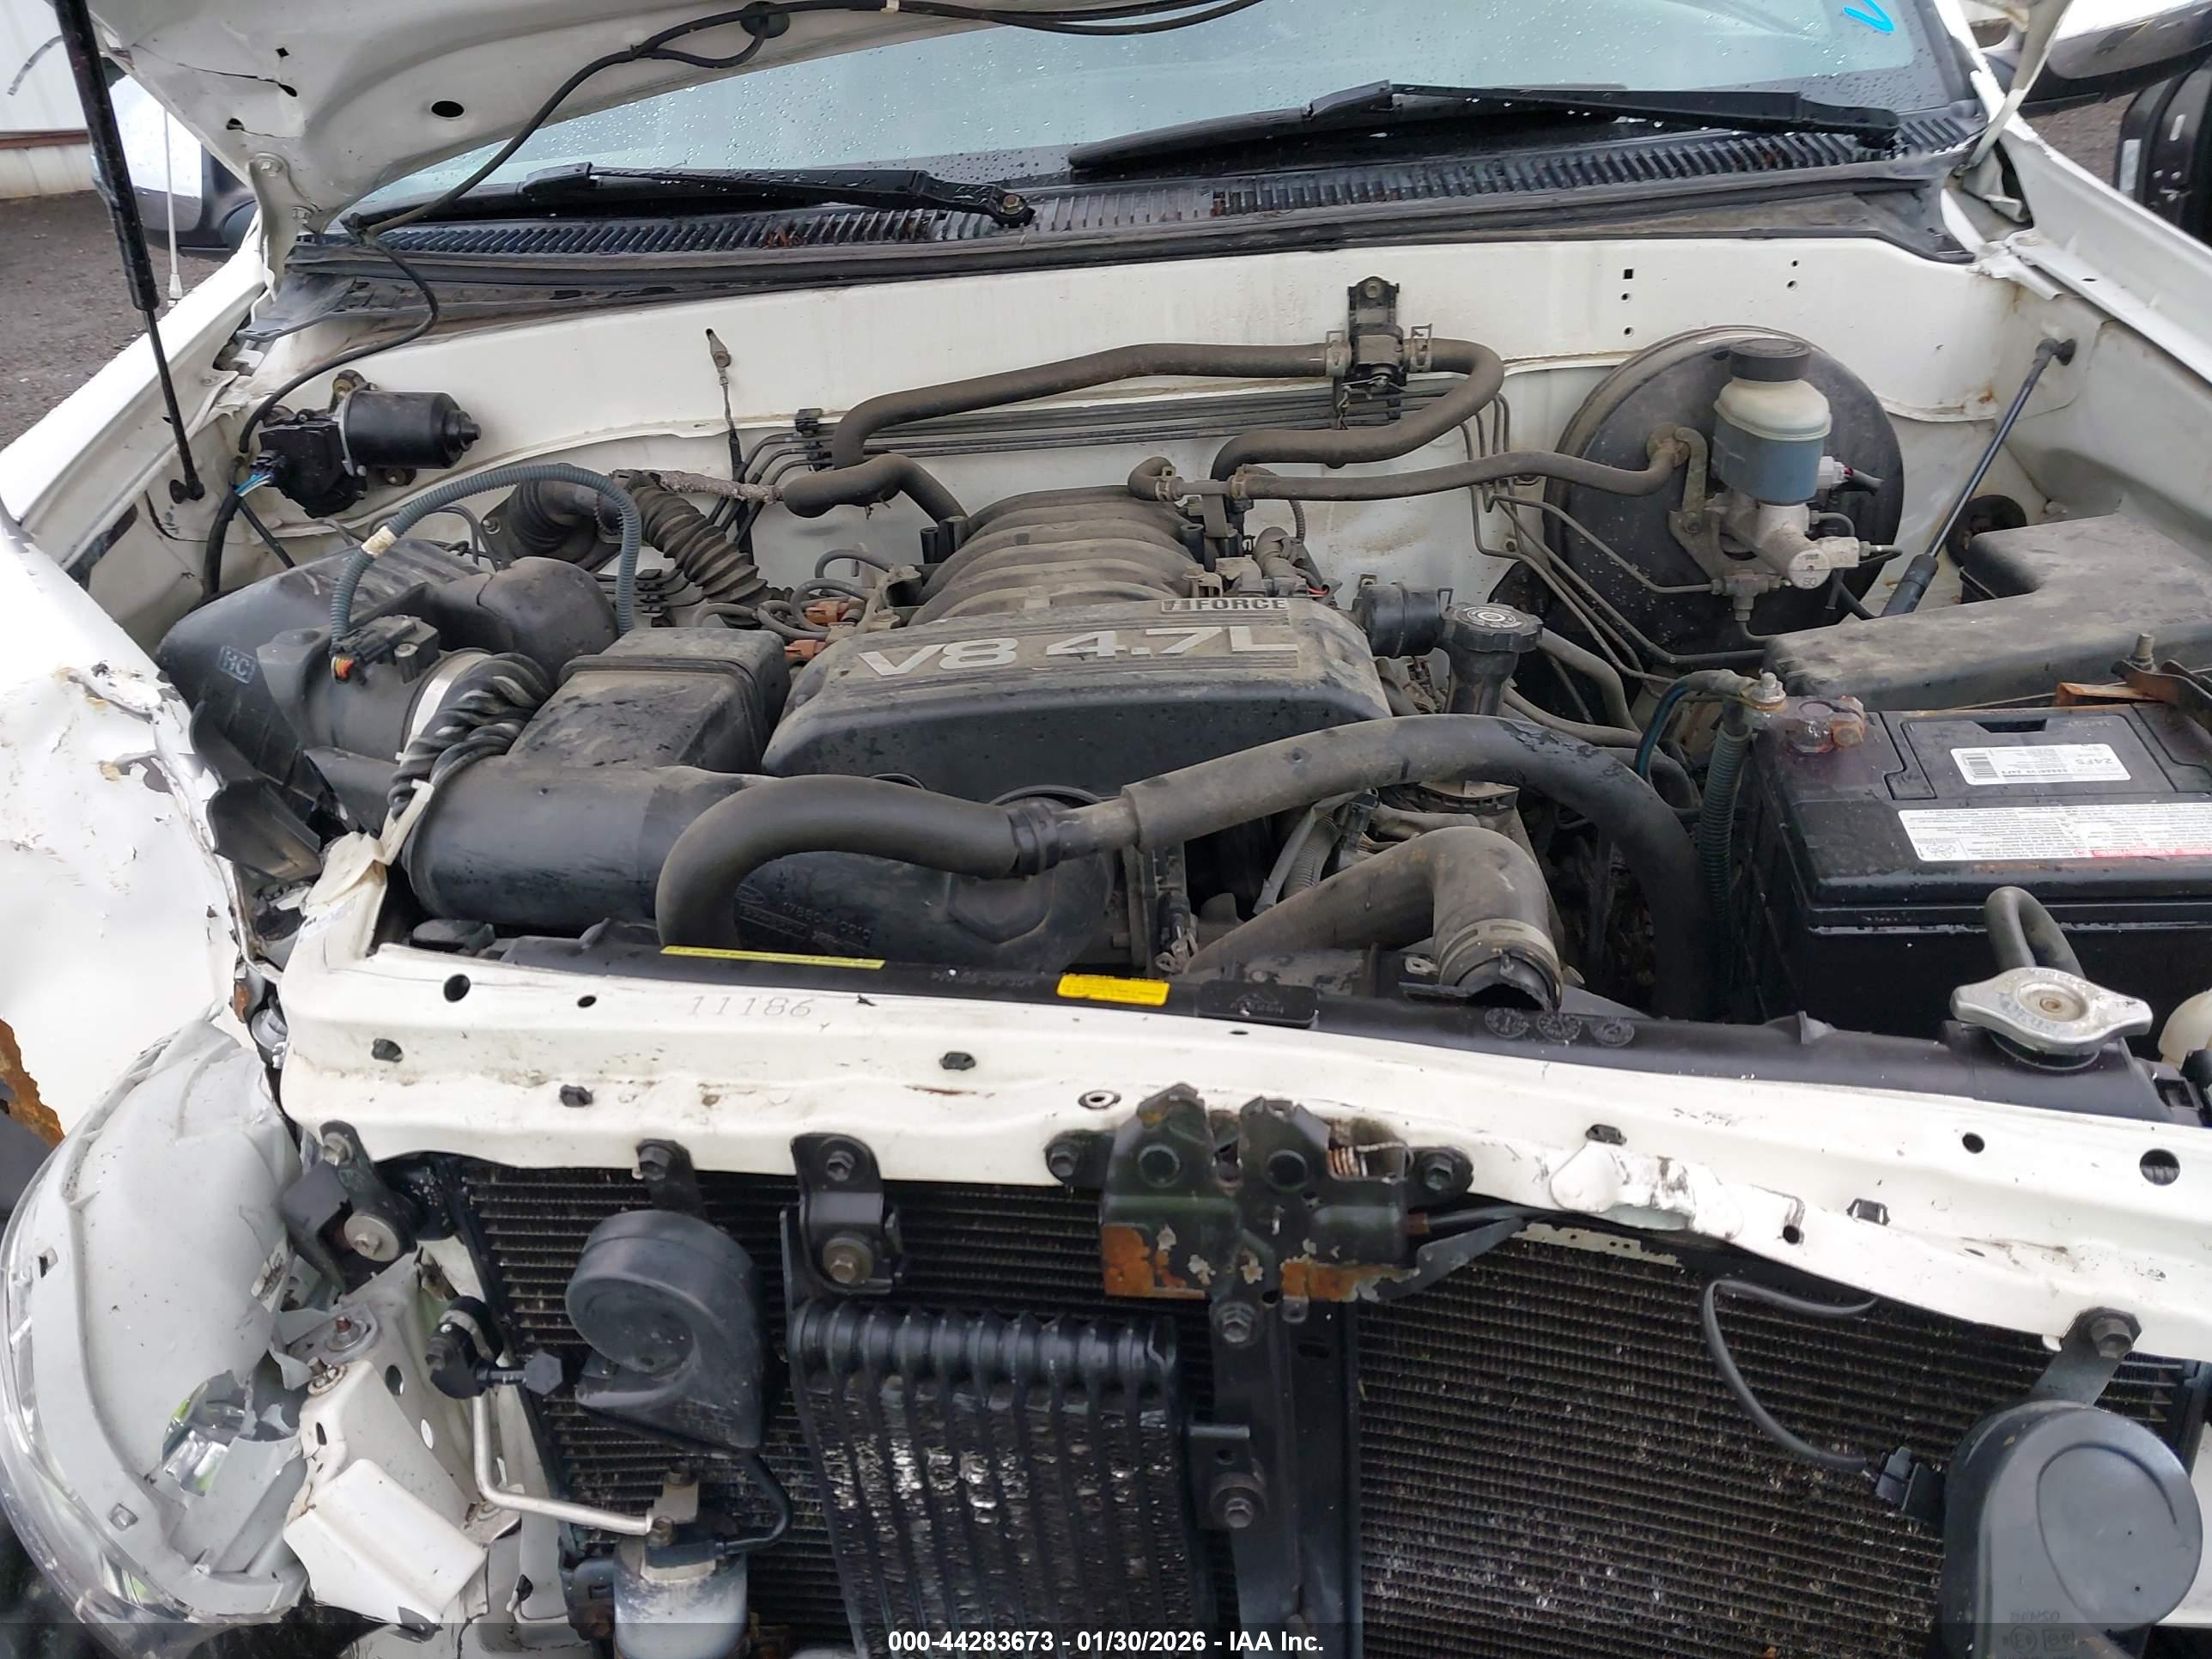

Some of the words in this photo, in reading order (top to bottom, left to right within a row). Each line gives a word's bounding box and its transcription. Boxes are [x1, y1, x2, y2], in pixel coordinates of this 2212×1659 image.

[858, 637, 1018, 677] V8
[1046, 625, 1299, 658] 4.7L
[689, 995, 815, 1017] 11186
